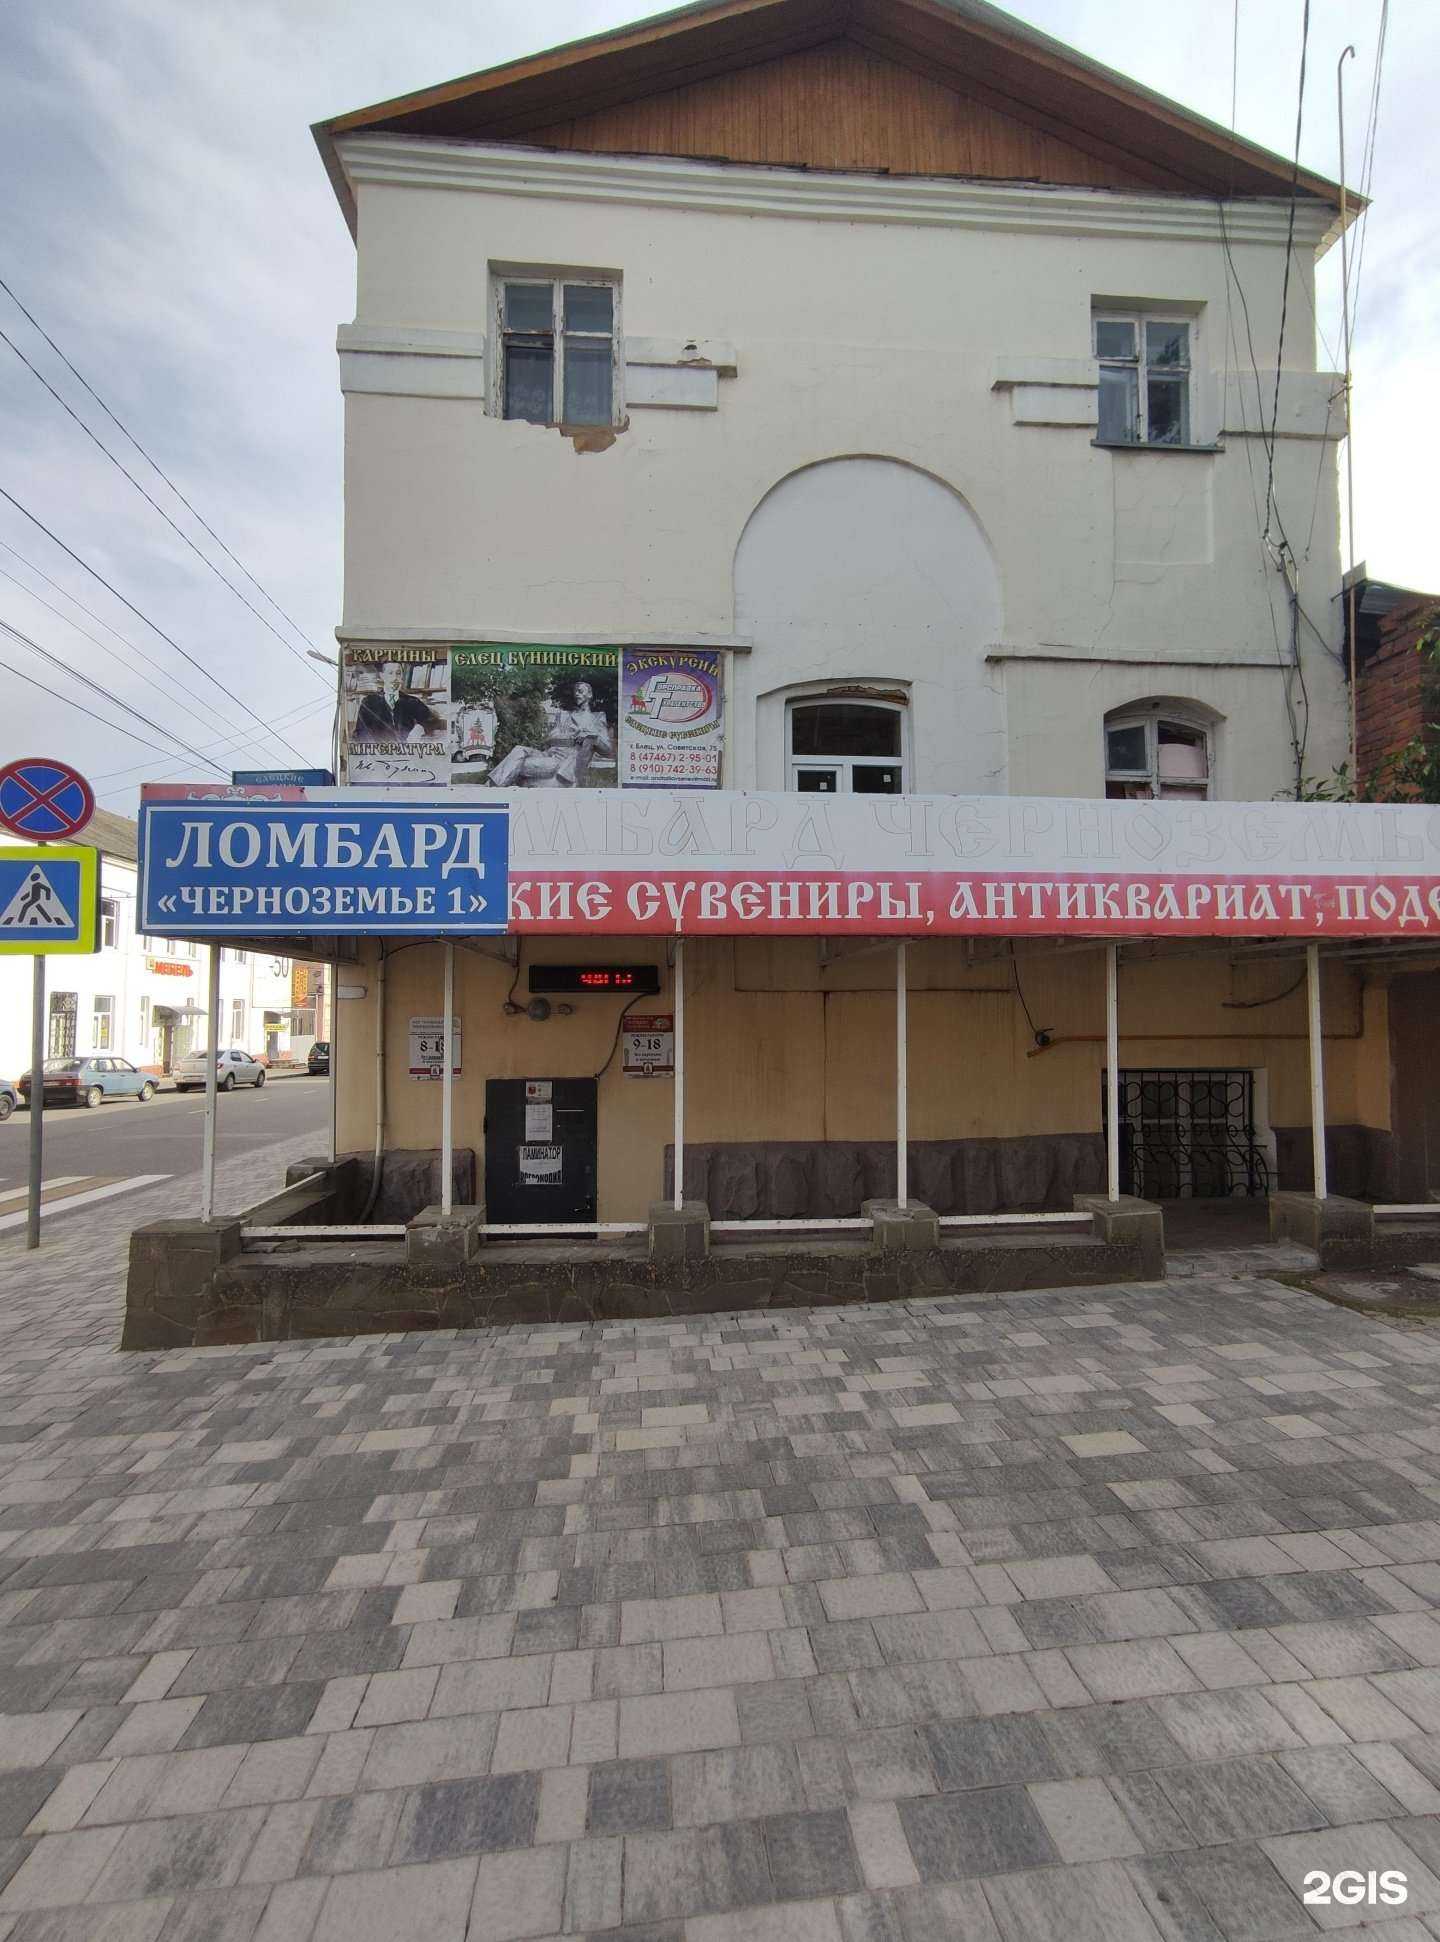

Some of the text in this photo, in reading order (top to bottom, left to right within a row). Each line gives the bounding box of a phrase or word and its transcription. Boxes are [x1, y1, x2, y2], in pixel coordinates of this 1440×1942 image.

[352, 648, 436, 662] КАРТИНЫ
[454, 651, 617, 668] ЕЛЕЦ БУНИНСКИЙ
[348, 742, 445, 758] ЛИТЕРАТУРА
[630, 752, 718, 762] 8 (47467) 2-95-01
[630, 763, 636, 772] 8
[166, 822, 485, 879] ЛОМБАРД
[158, 887, 488, 914] «ЧЕРНОЗЕМЬЕ 1»
[508, 881, 613, 920] КИЕ
[627, 881, 935, 932] СУВЕНИРЫ,
[950, 882, 1324, 927] АНТИКВАРИАТ,
